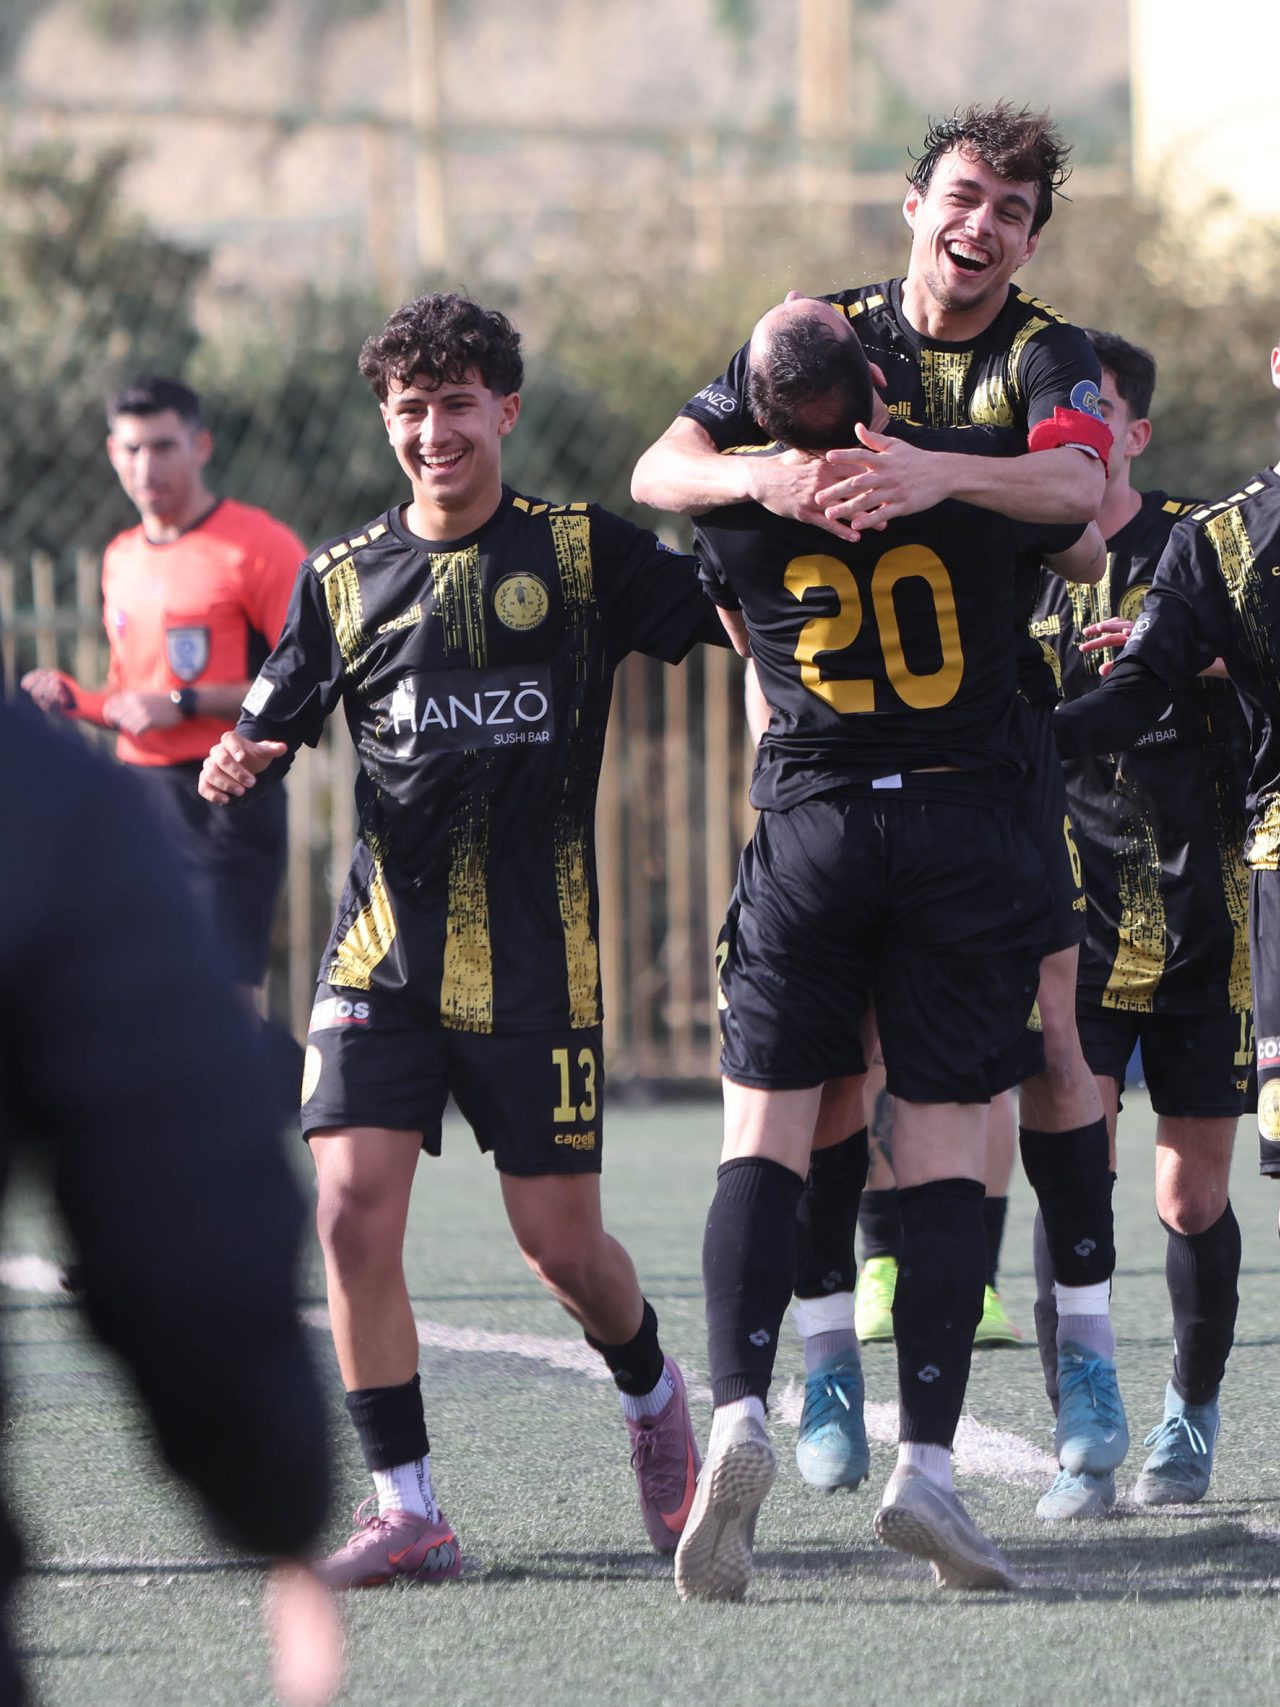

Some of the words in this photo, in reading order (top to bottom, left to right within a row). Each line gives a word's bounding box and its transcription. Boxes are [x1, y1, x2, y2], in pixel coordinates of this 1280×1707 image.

[695, 384, 738, 412] ANZŌ
[888, 401, 911, 416] elli
[377, 603, 422, 634] capelli
[784, 543, 965, 714] 20
[1030, 614, 1061, 636] pelli
[494, 732, 526, 745] SUSHI
[528, 731, 550, 743] BAR
[1155, 728, 1177, 742] BAR
[552, 1048, 597, 1123] 13
[554, 1130, 596, 1149] capelli
